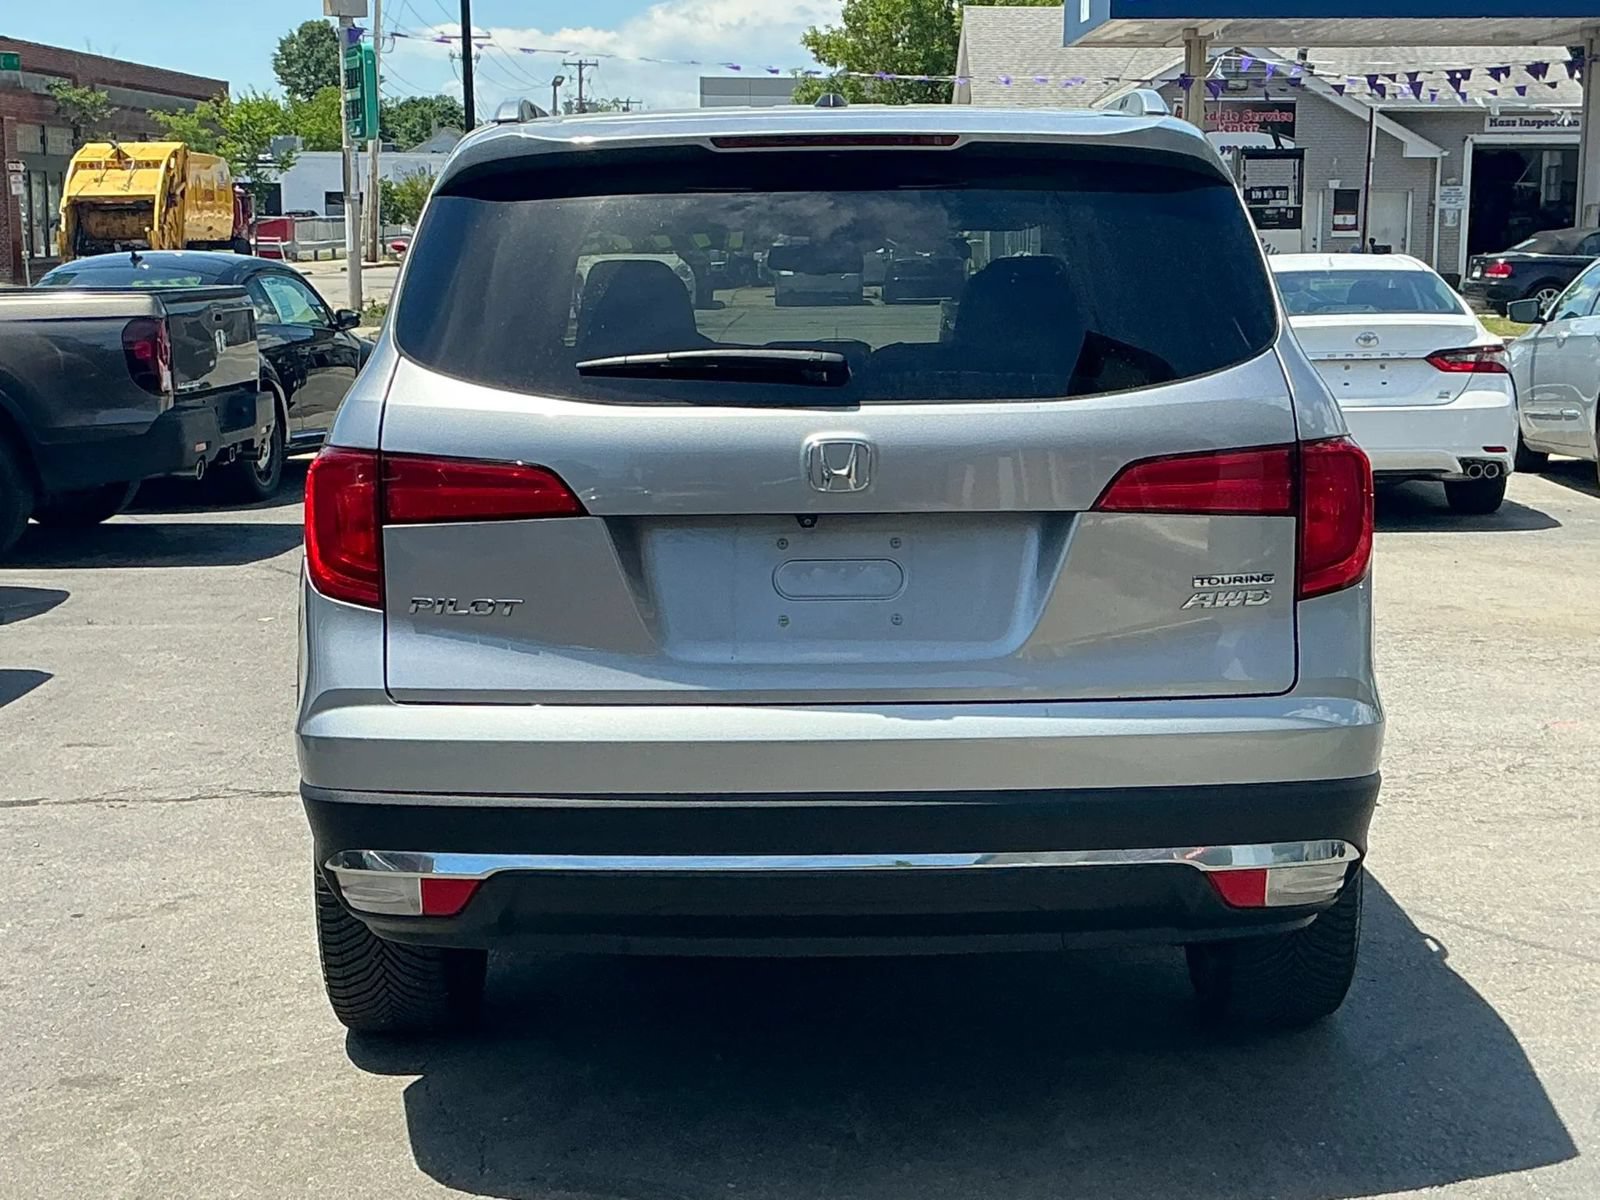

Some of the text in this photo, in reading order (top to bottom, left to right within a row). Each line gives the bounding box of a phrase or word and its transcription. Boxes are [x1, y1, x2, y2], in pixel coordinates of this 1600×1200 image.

[1242, 109, 1293, 122] Service
[1489, 118, 1516, 127] Mass
[1193, 573, 1275, 586] TOURING
[1181, 589, 1272, 609] AWD
[408, 596, 524, 616] PILOT
